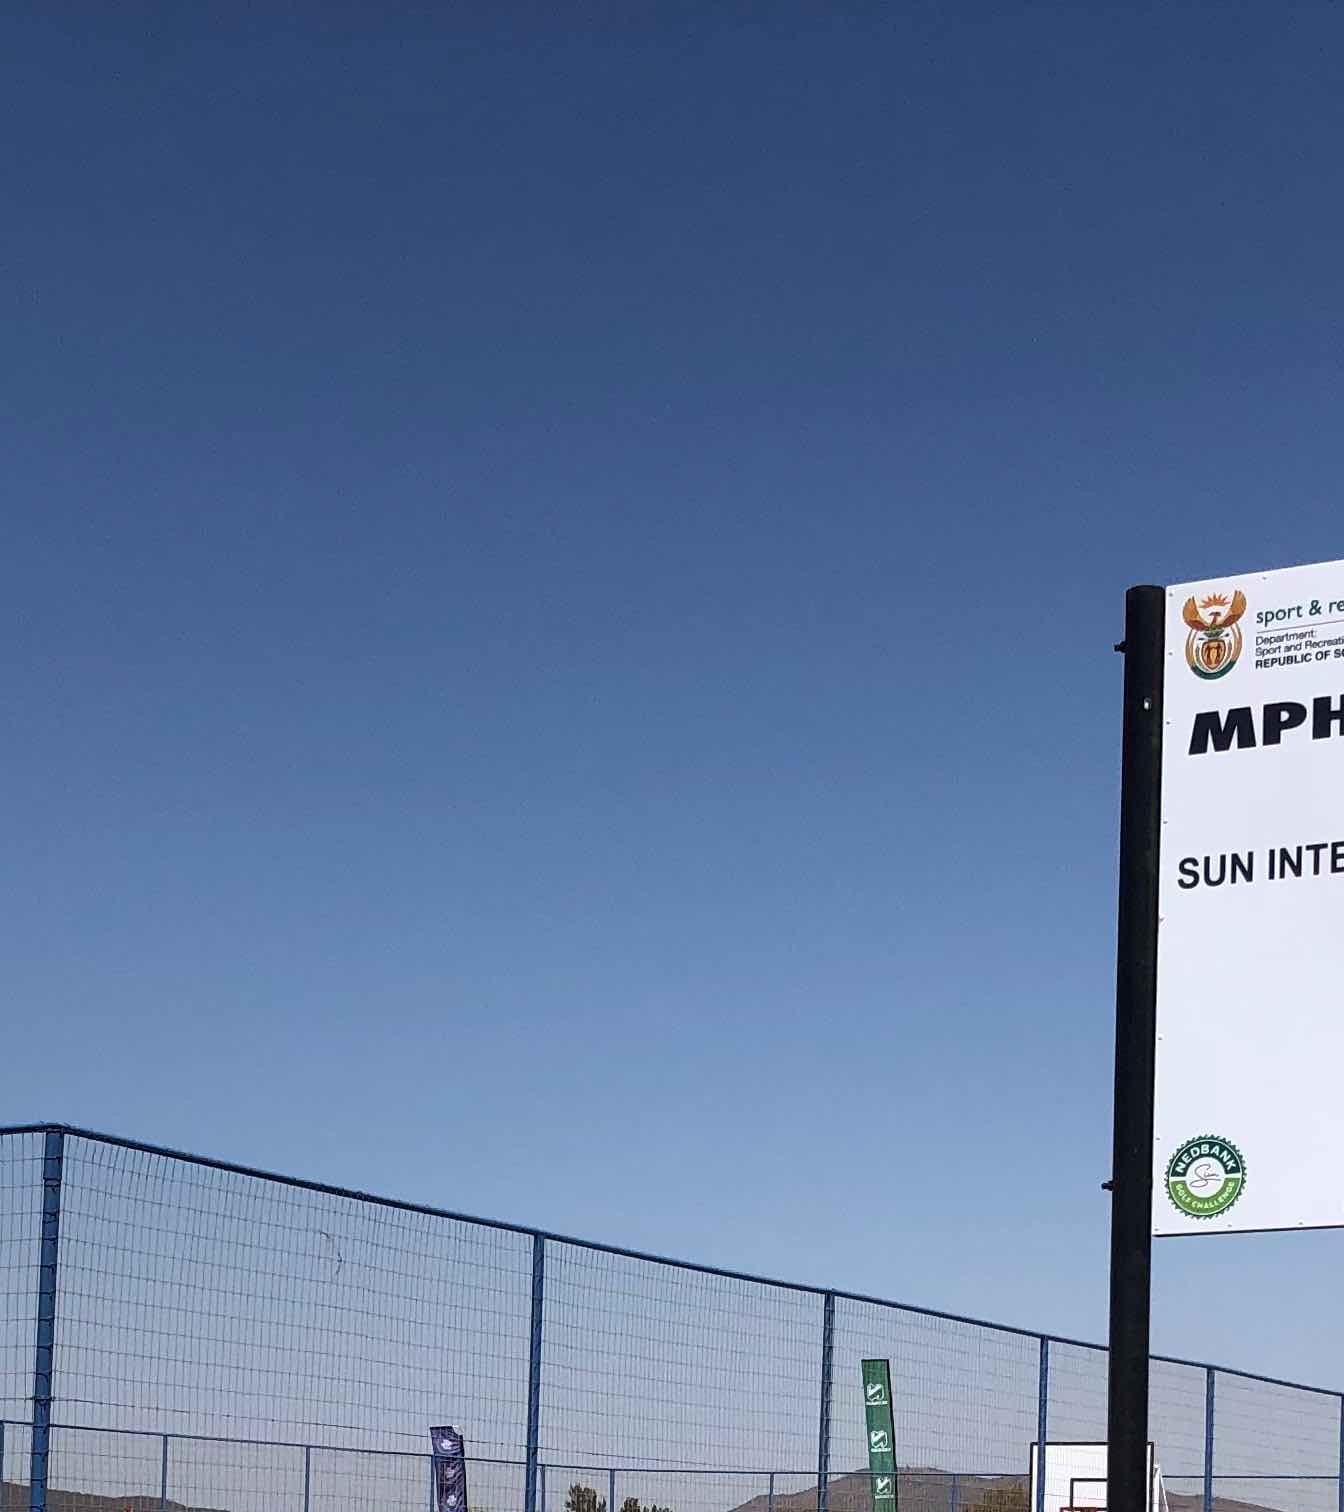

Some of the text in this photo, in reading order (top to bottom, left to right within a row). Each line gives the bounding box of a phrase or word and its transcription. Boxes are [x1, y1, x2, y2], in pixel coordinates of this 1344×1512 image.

[1256, 604, 1303, 627] sport
[1308, 600, 1322, 616] &
[1255, 629, 1317, 646] Department:
[1255, 644, 1282, 659] Sport
[1284, 642, 1302, 653] and
[1255, 653, 1313, 670] REPUBLIC
[1315, 649, 1331, 662] OF
[1177, 850, 1254, 890] SUN
[1175, 1143, 1237, 1173] NEDBANK
